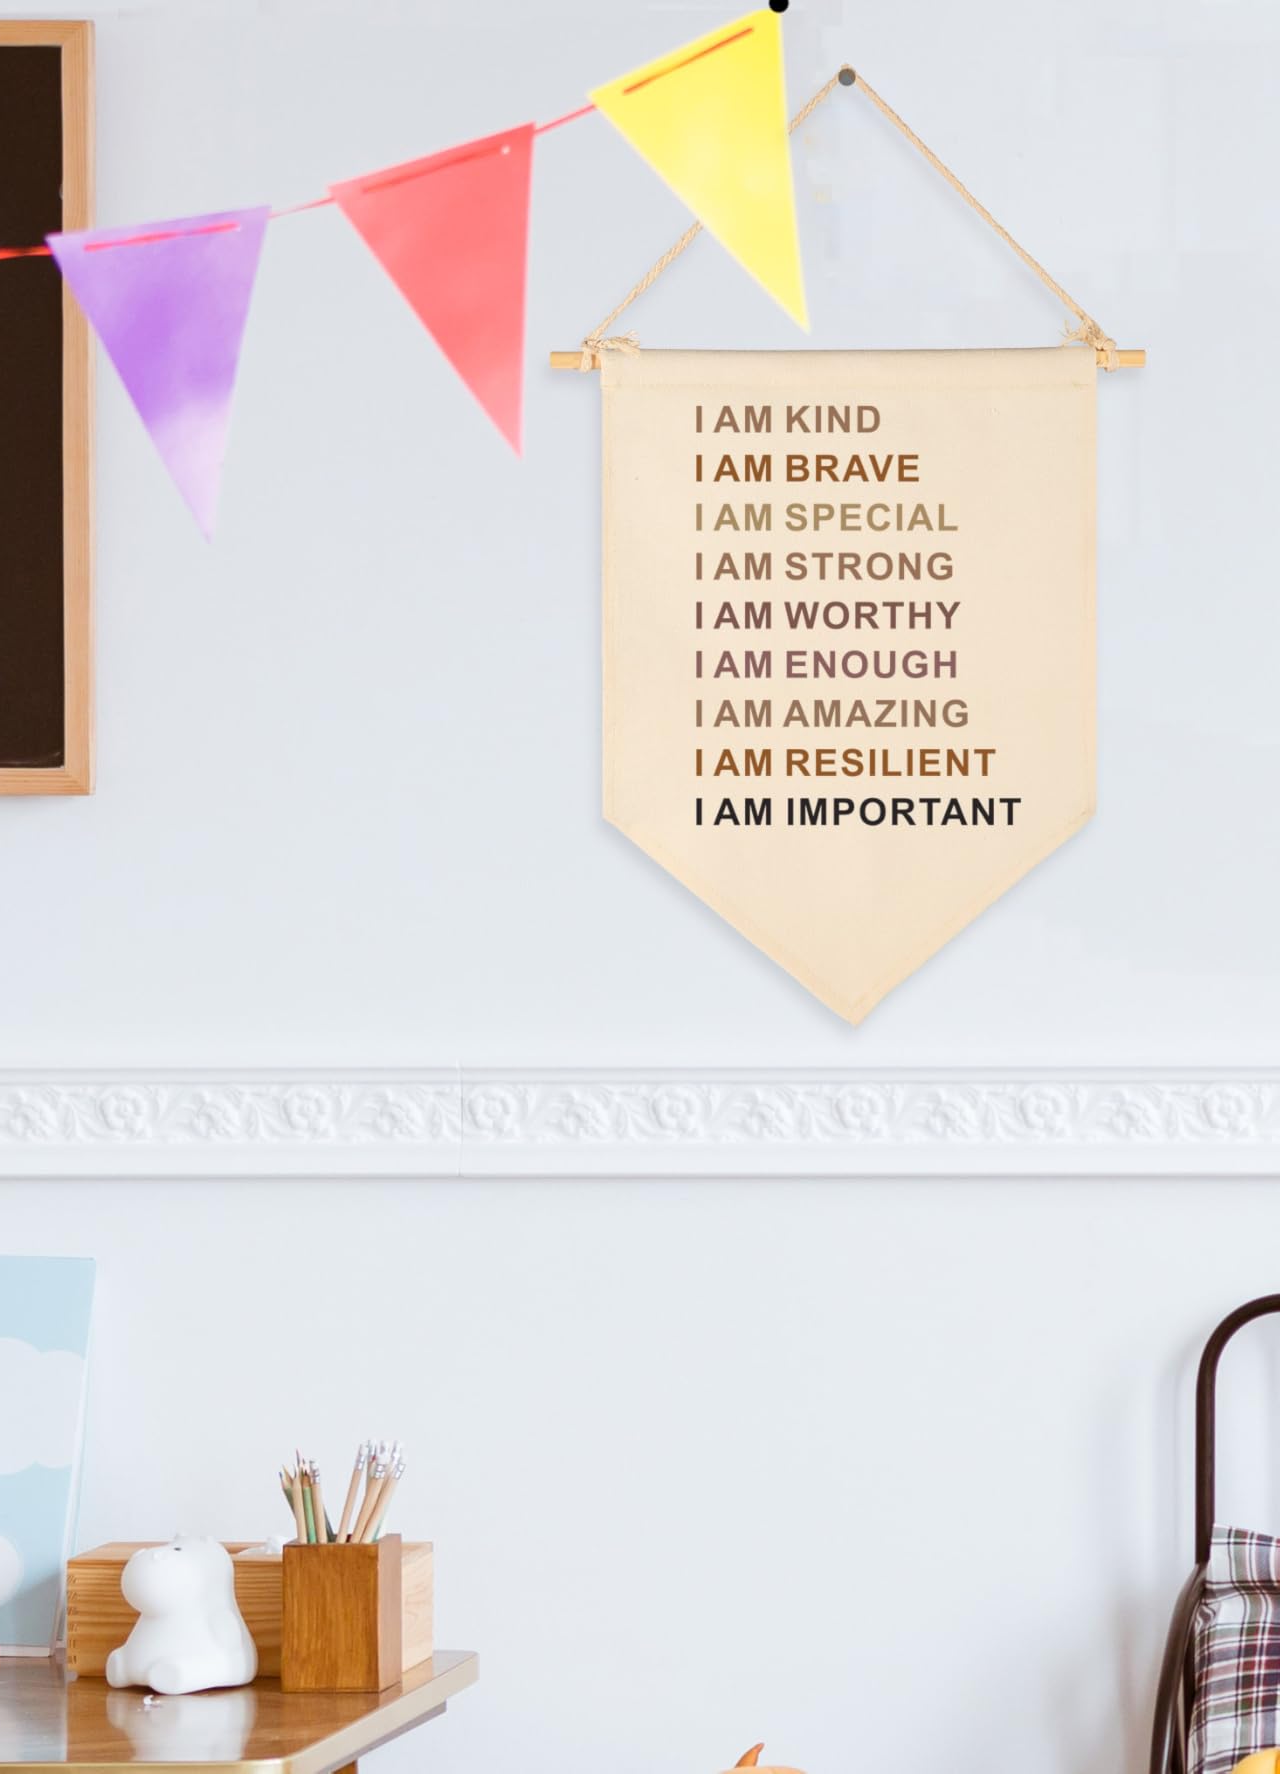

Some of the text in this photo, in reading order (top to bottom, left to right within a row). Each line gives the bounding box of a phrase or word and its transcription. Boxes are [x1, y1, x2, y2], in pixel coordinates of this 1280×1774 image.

[695, 404, 881, 434] I AM KIND
[695, 453, 920, 483] I AM BRAVE
[695, 502, 959, 532] I AM SPECIAL
[695, 551, 953, 581] I AM STRONG
[695, 600, 961, 630] I AM WORTHY
[695, 649, 957, 679] I AM ENOUGH
[695, 698, 969, 728] I AM AMAZING
[695, 747, 997, 778] I AM RESILIENT
[695, 796, 1022, 827] I AM IMPORTANT
